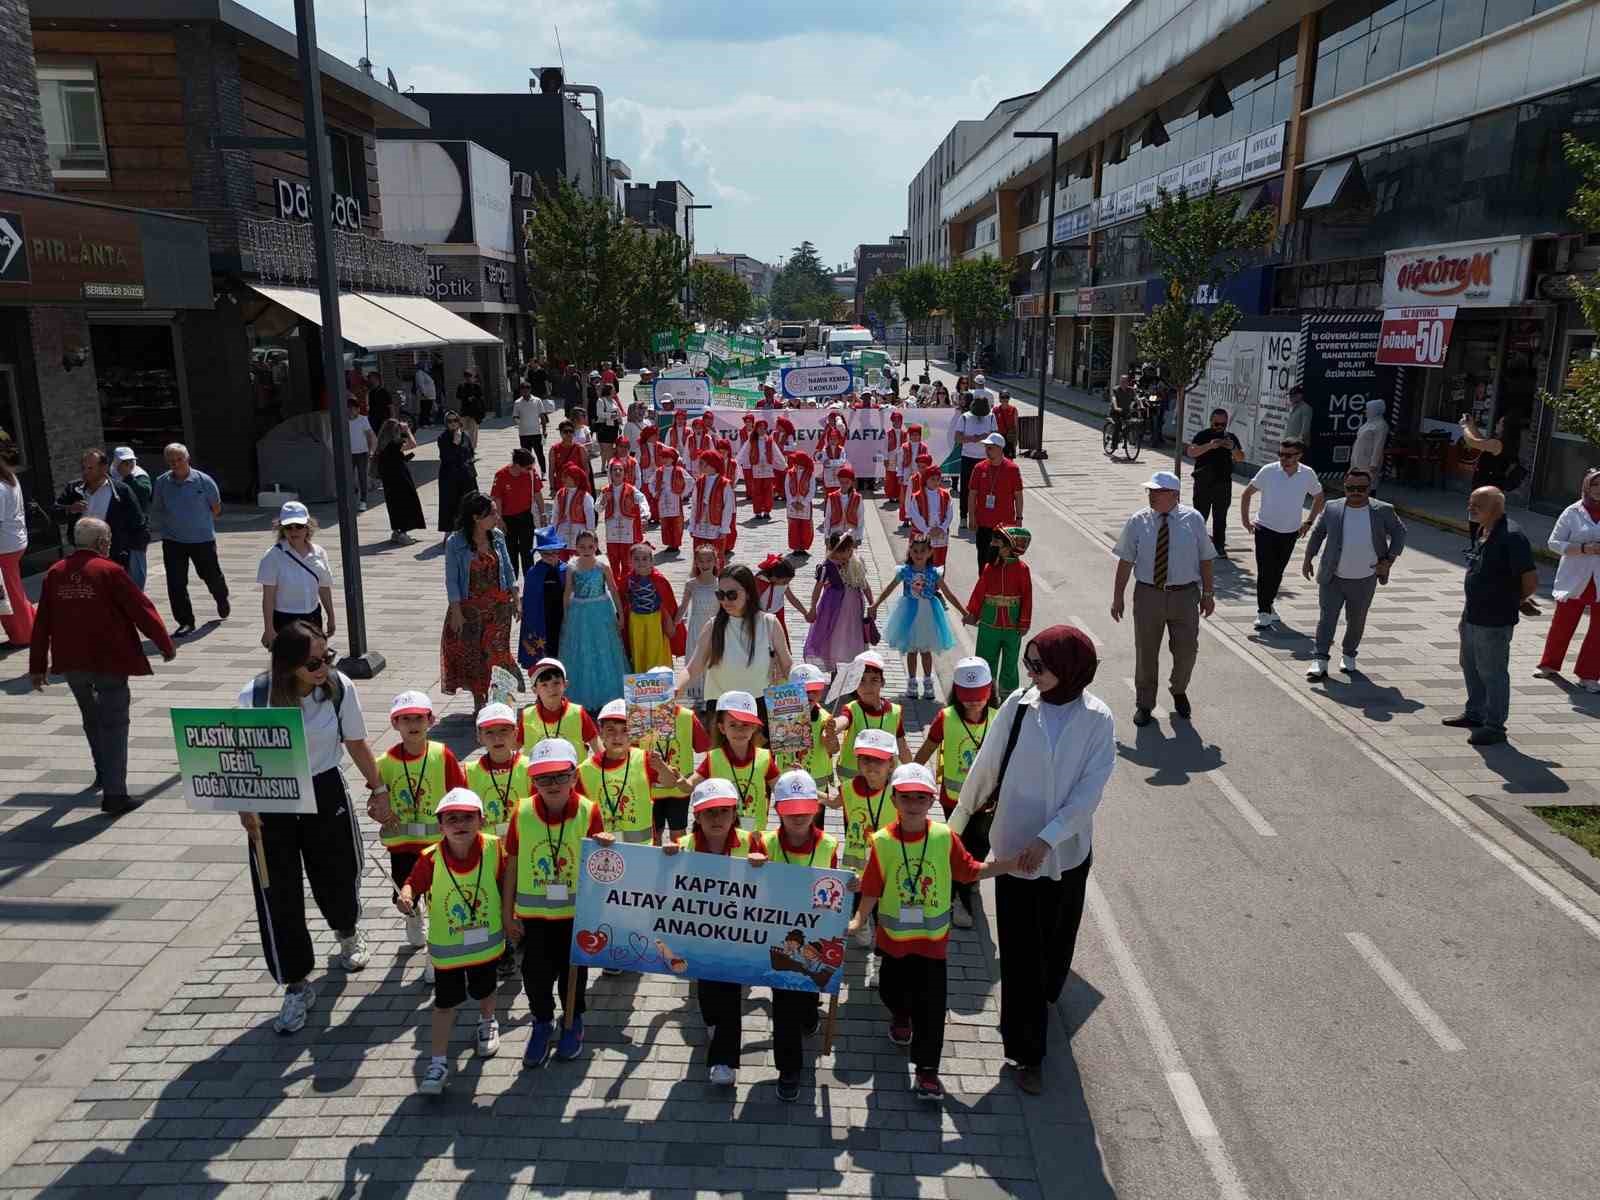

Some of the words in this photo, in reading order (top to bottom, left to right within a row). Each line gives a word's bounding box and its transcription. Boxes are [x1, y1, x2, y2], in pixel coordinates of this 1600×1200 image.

[1382, 331, 1416, 350] DÜRÜM
[186, 723, 236, 747] PLASTİK
[238, 727, 290, 747] ATIKLAR
[220, 749, 262, 775] DEĞİL,
[194, 771, 227, 797] DOĞA
[231, 777, 298, 798] KAZANSIN!
[674, 874, 758, 899] KAPTAN
[606, 889, 668, 910] ALTAY
[671, 896, 738, 919] ALTUĞ
[743, 905, 821, 929] KIZILAY
[653, 917, 768, 945] ANAOKULU
